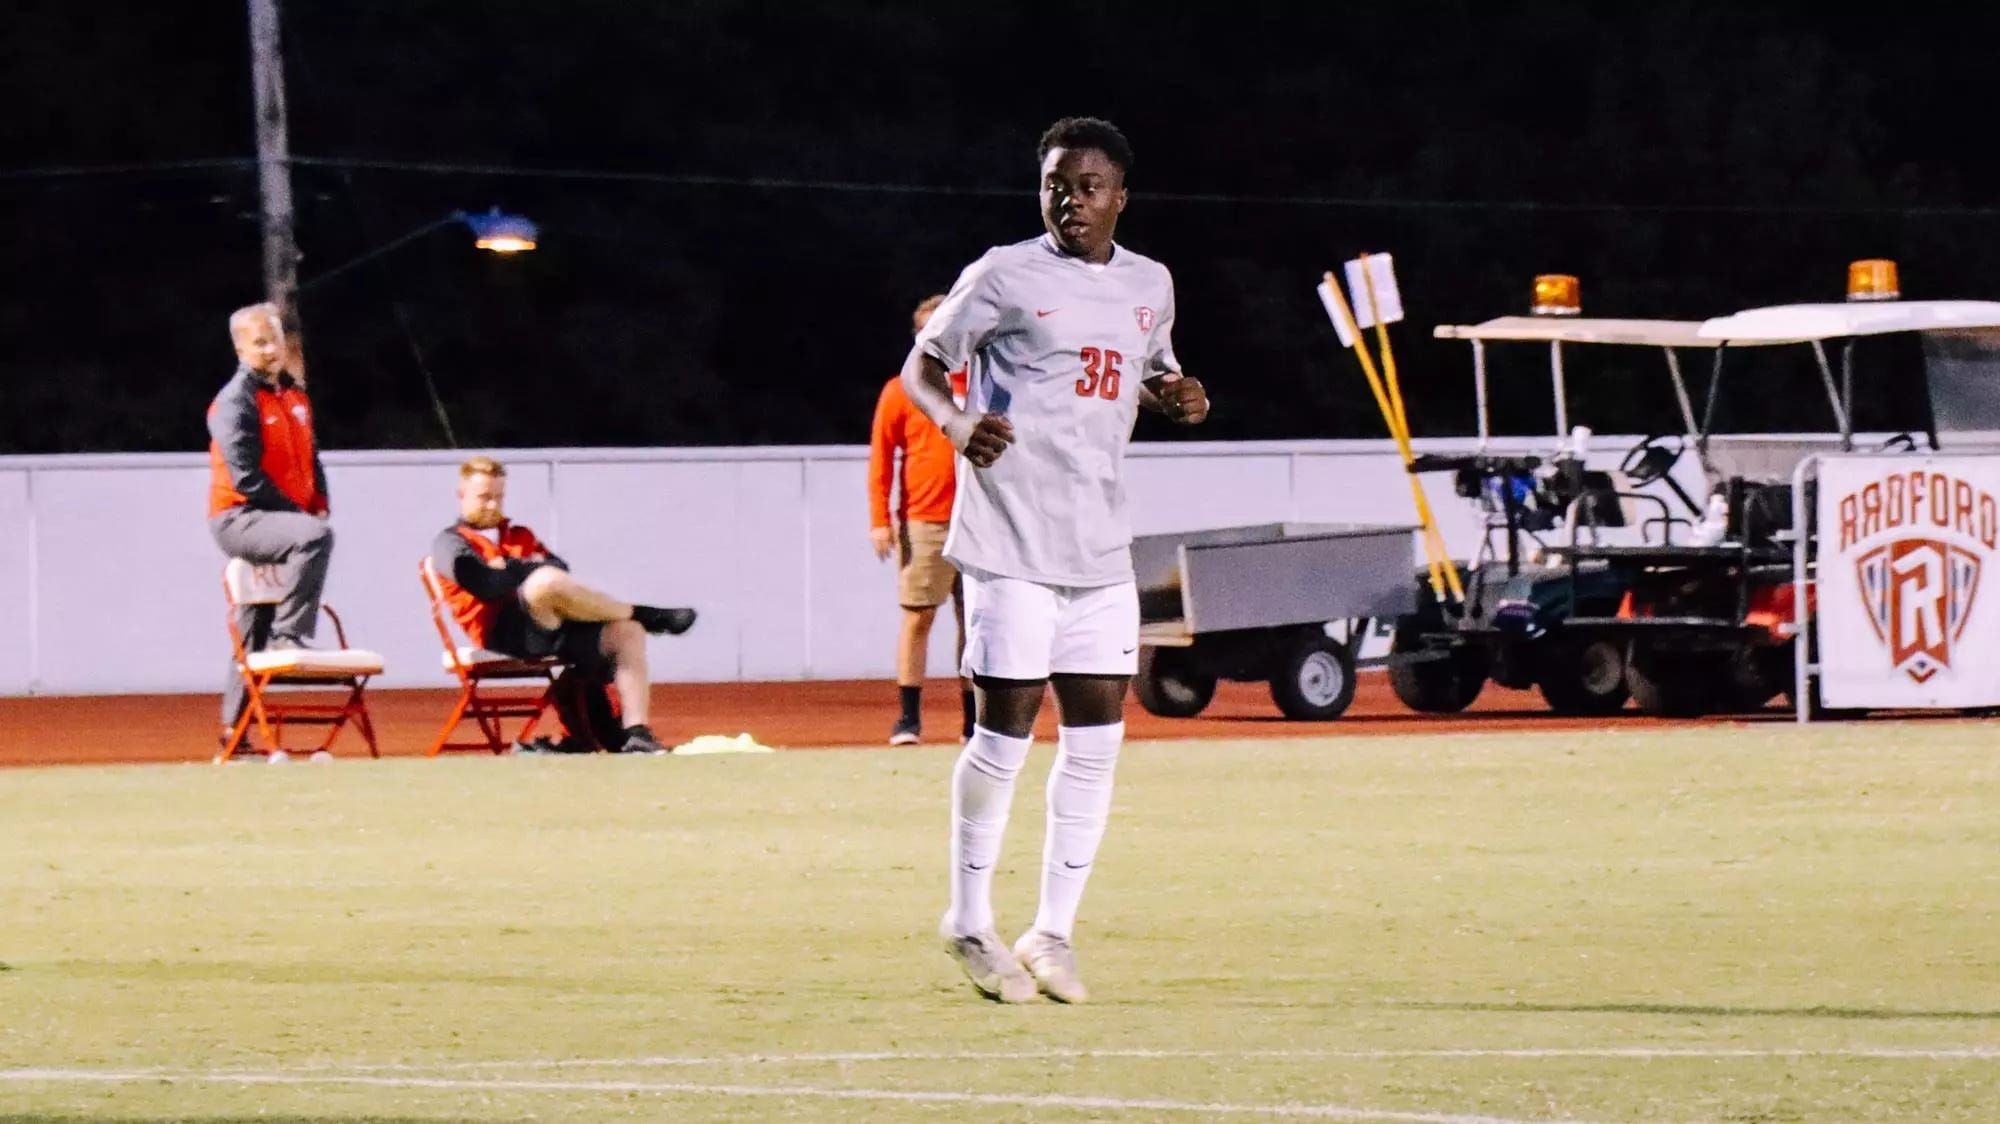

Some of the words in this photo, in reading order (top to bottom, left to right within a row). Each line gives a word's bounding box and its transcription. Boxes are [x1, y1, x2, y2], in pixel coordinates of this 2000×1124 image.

[1075, 347, 1123, 401] 36
[1840, 471, 1998, 553] RADFORD
[1893, 546, 1946, 651] R
